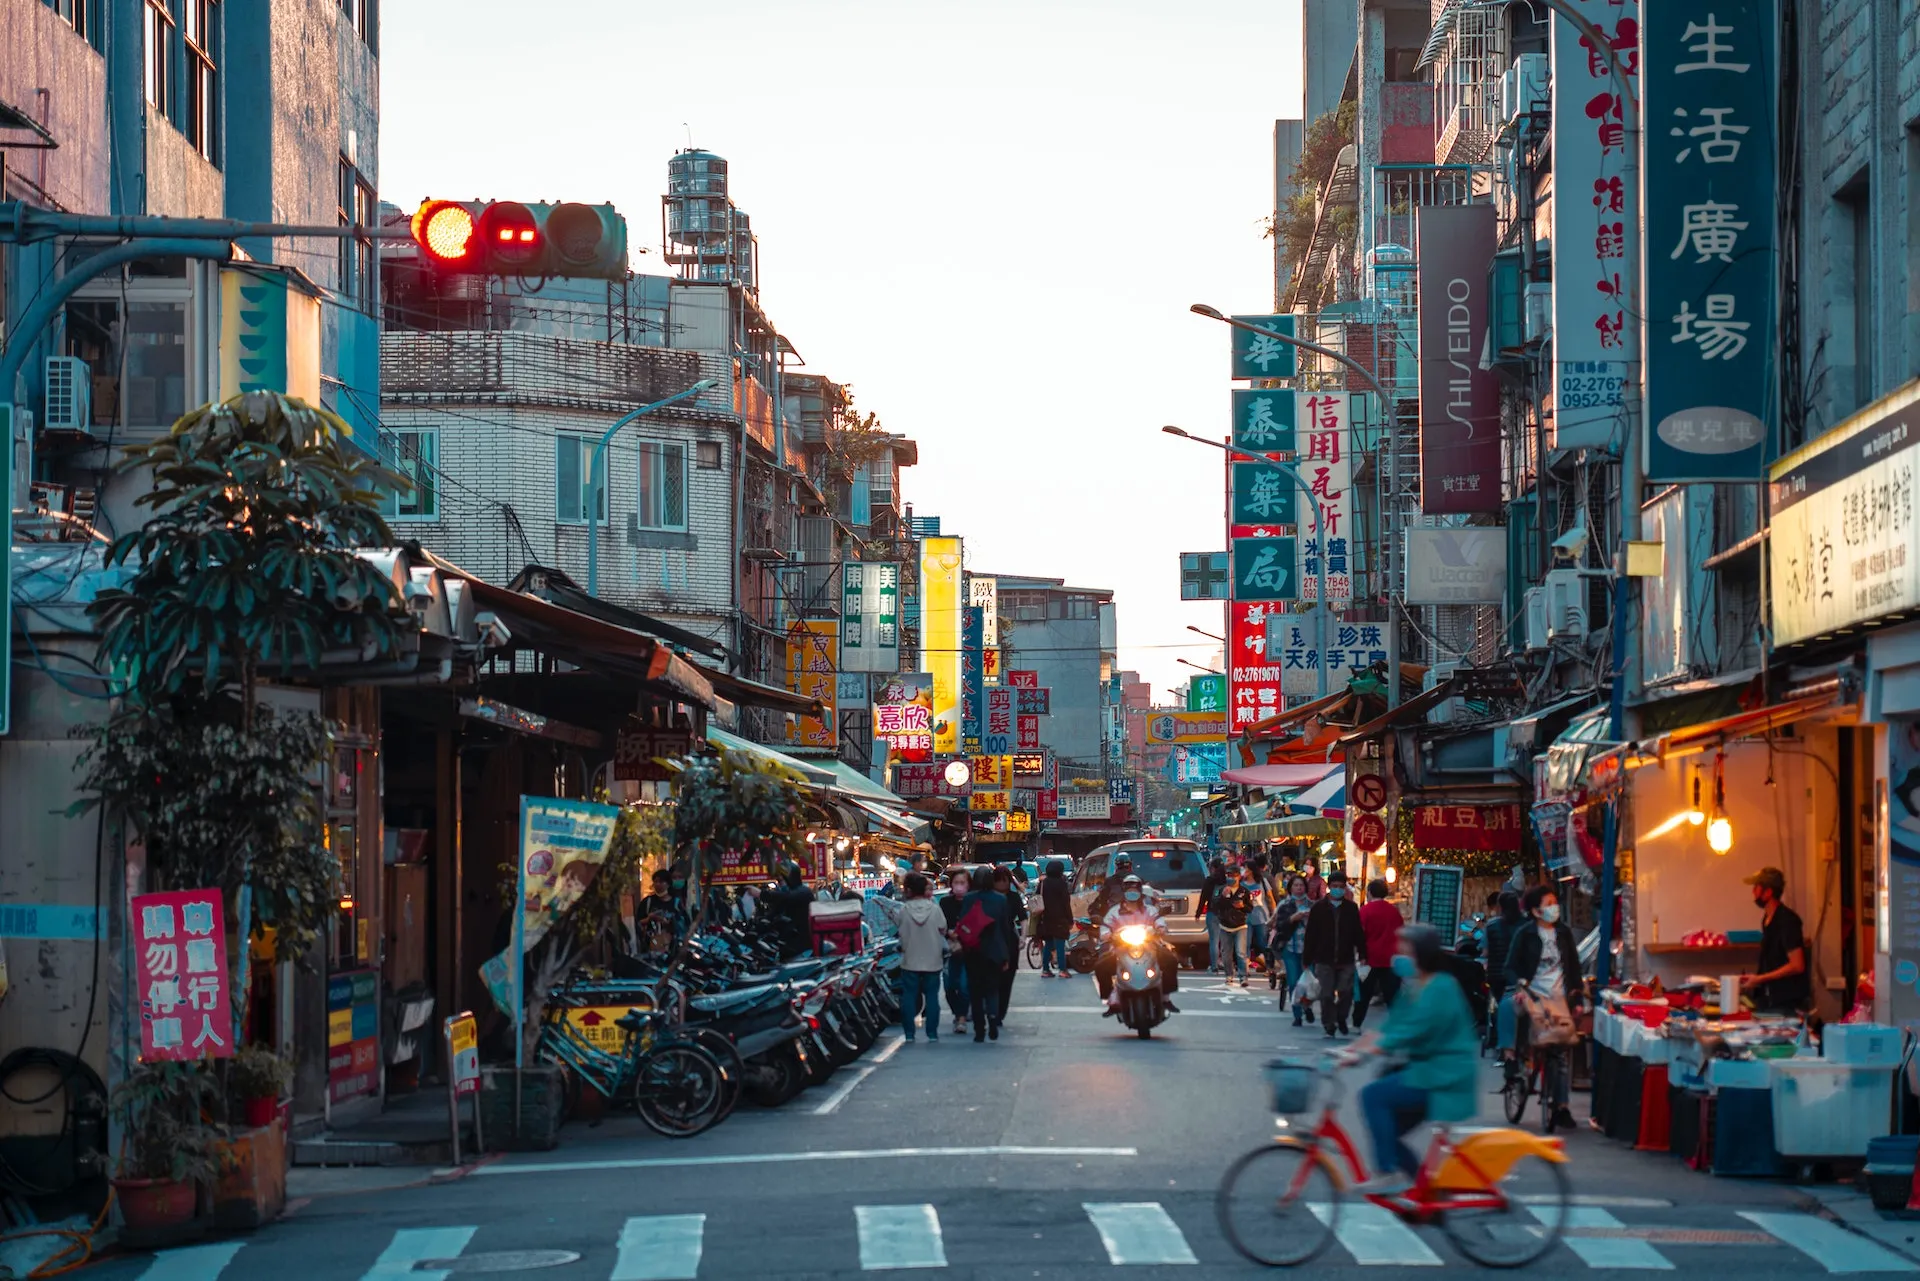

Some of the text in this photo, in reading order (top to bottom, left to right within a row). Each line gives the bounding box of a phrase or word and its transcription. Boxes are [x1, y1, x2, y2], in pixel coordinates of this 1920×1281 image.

[1670, 13, 1750, 360] 生活廣場
[1446, 278, 1474, 440] SHISEIDO
[1242, 322, 1288, 592] 華泰藥局
[1306, 395, 1342, 536] 信用瓦斯
[1669, 421, 1757, 443] 嬰兒車
[1327, 538, 1348, 575] 爐具
[880, 566, 896, 645] 美利達
[878, 705, 930, 733] 嘉欣
[989, 689, 1011, 734] 剪髮
[1359, 821, 1379, 844] 停
[142, 904, 186, 1051] 請勿停車
